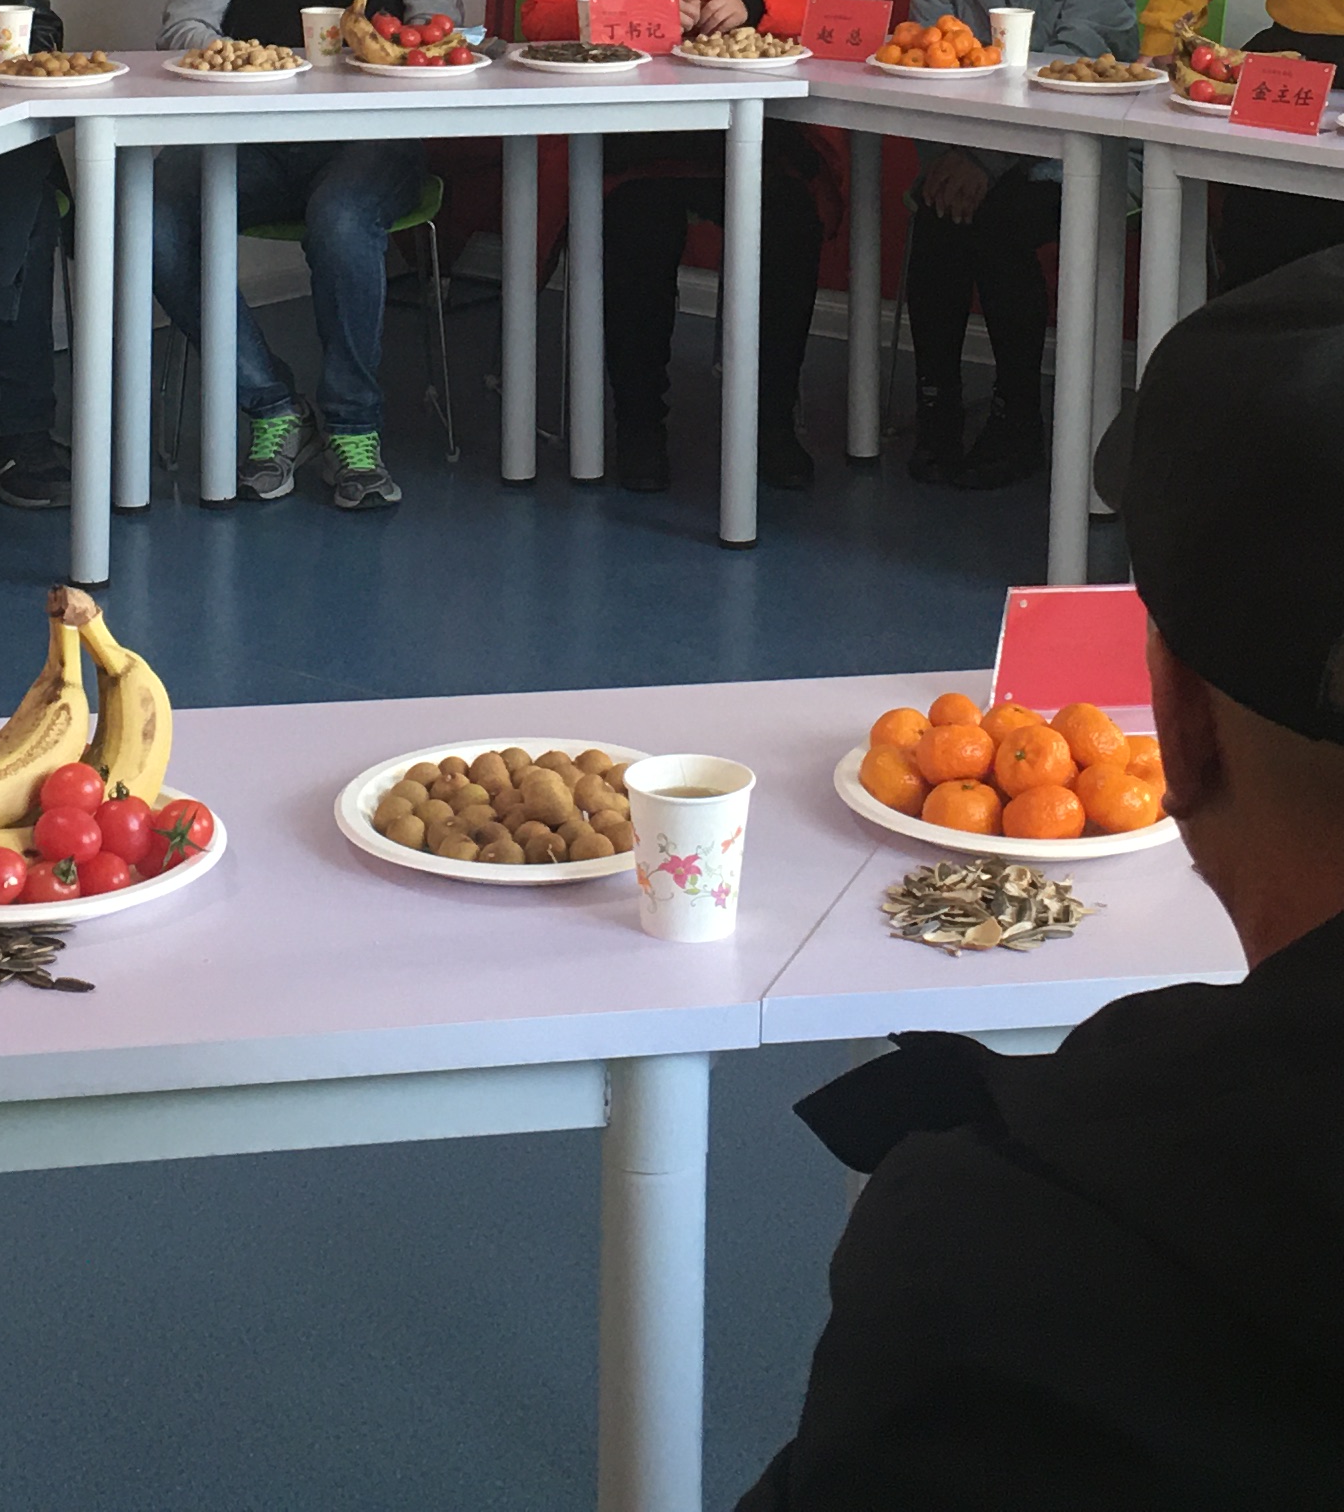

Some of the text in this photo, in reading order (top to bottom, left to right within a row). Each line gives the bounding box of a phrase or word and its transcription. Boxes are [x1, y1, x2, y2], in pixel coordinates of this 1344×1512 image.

[603, 21, 665, 41] 丁书记
[1252, 81, 1314, 106] 金主任
